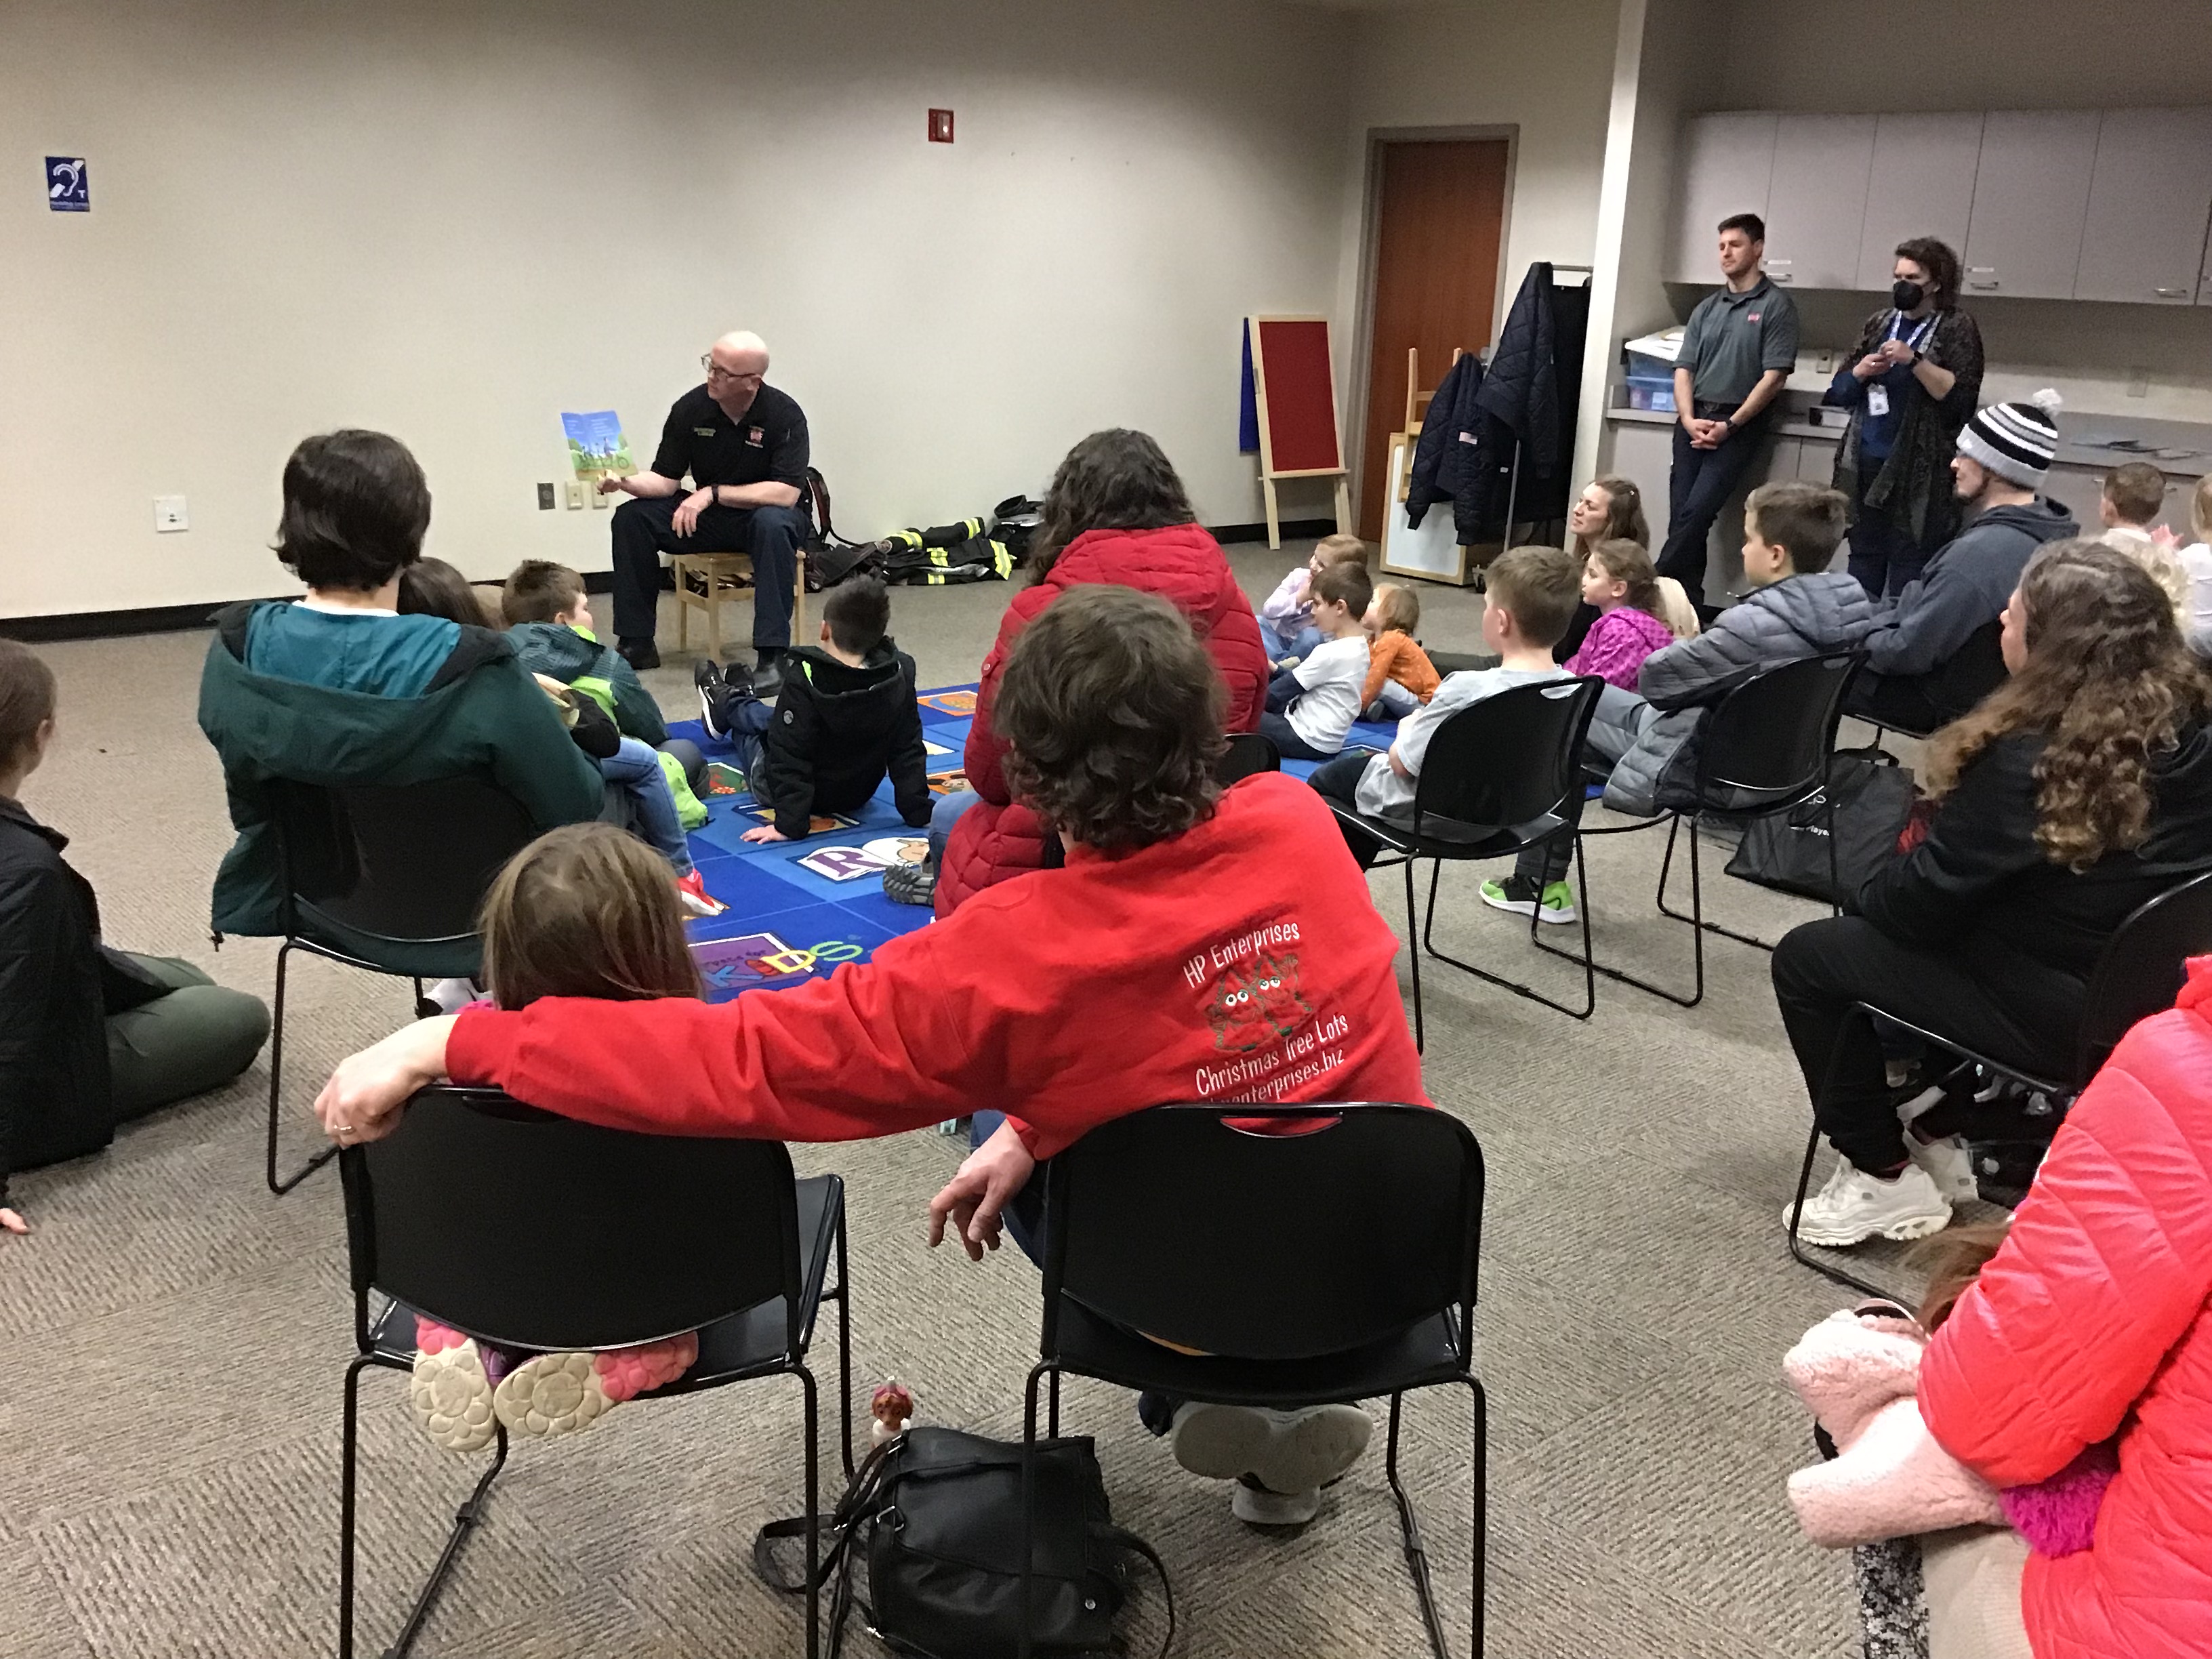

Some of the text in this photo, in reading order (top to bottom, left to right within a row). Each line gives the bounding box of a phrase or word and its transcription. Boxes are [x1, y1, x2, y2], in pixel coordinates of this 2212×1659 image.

[78, 189, 85, 199] T
[806, 850, 889, 878] R
[1183, 922, 1300, 988] HP Enterprises
[1195, 1014, 1349, 1096] Christmas Tree Lots
